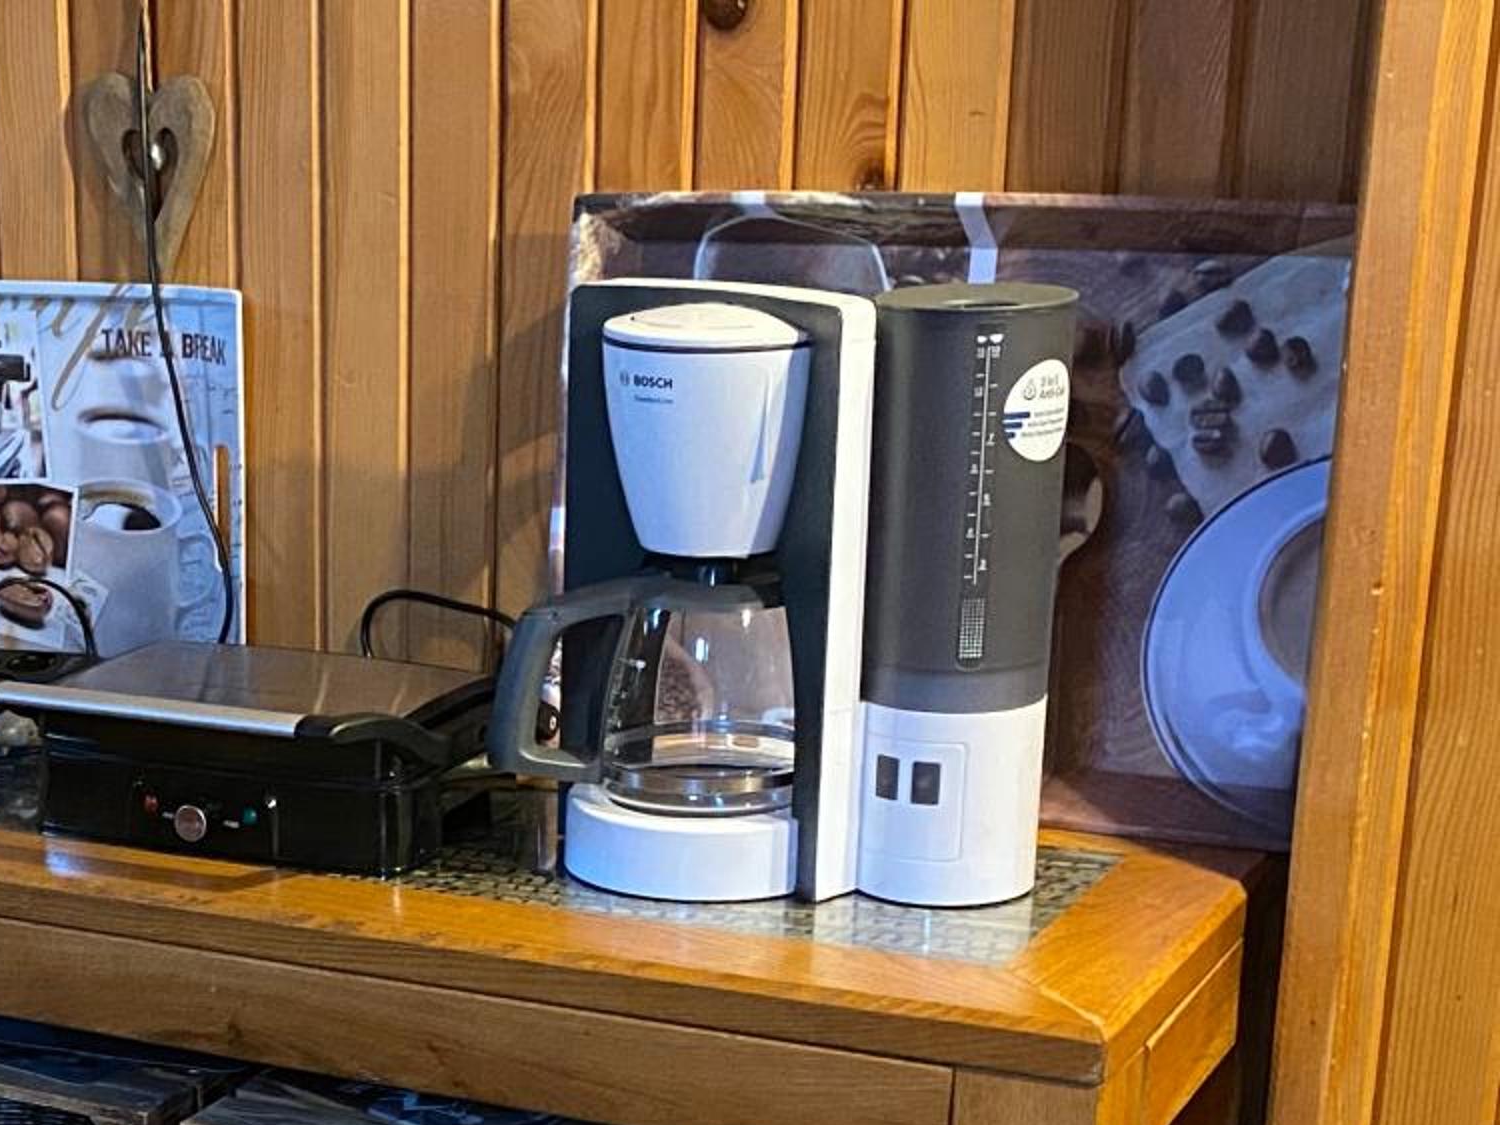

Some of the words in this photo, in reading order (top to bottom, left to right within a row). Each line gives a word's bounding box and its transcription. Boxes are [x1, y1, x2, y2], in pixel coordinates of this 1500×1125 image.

[101, 328, 152, 357] TAKE
[181, 333, 227, 366] BREAK
[633, 374, 674, 390] BOSCH
